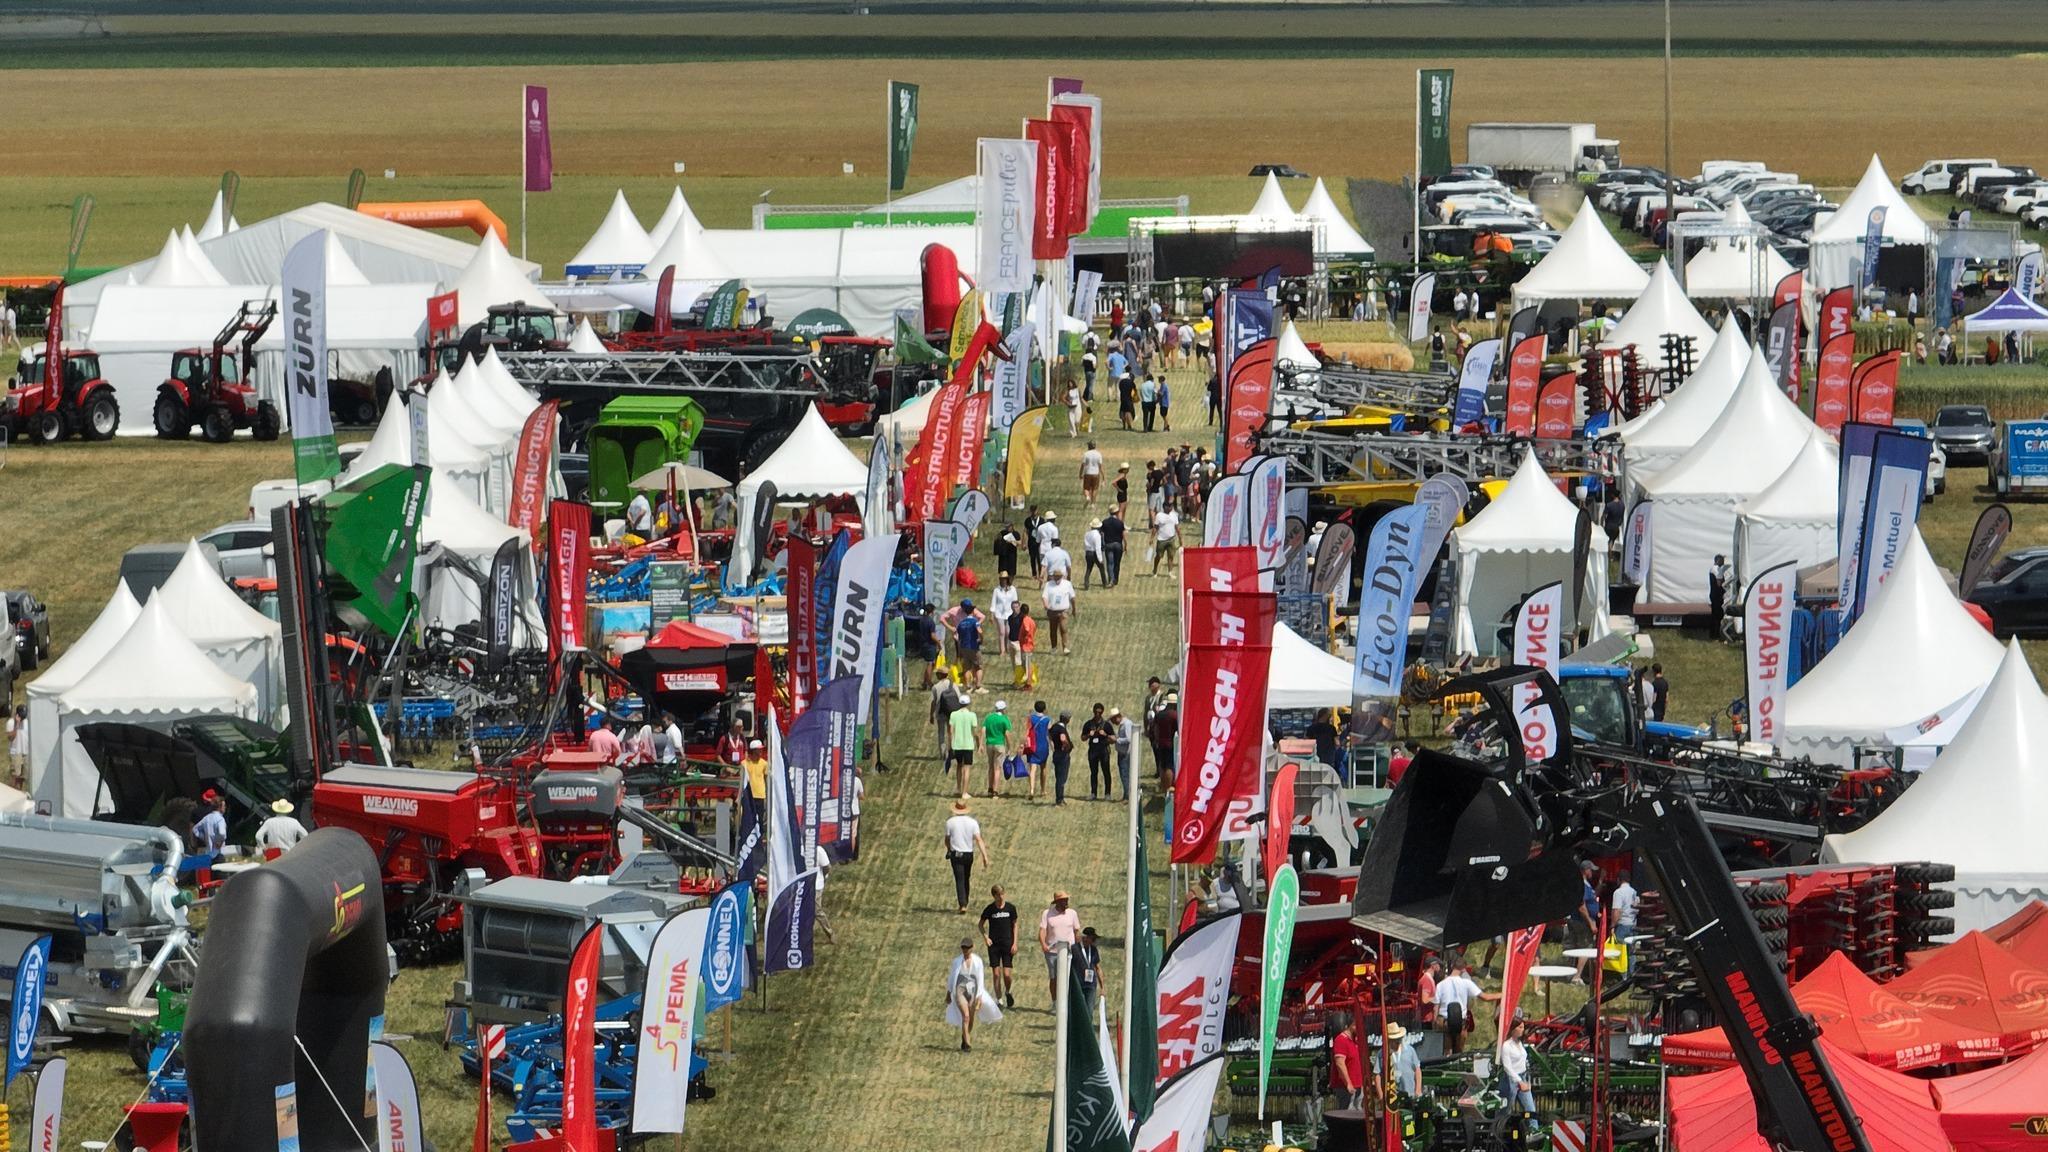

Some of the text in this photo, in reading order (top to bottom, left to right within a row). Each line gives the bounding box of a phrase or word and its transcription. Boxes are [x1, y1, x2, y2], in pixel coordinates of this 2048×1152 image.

[1431, 75, 1443, 117] BASF
[1045, 145, 1057, 239] McCORMICK
[2022, 263, 2034, 299] ANQUE
[291, 287, 317, 399] ZÜRN
[1883, 511, 1903, 569] Mutuel
[497, 564, 511, 646] HORIZON
[834, 580, 869, 678] ZÜRN
[1360, 519, 1414, 688] Eco-Dyn
[843, 712, 856, 766] BUSINESS
[1191, 667, 1239, 814] HORSCH
[362, 795, 418, 810] WEAVING
[547, 786, 598, 798] WEAVING
[805, 768, 818, 826] BUSINESS
[840, 820, 851, 841] THE
[716, 902, 734, 981] BONNEL
[17, 954, 41, 1045] BONNEL
[1790, 1051, 1856, 1151] MANITOU
